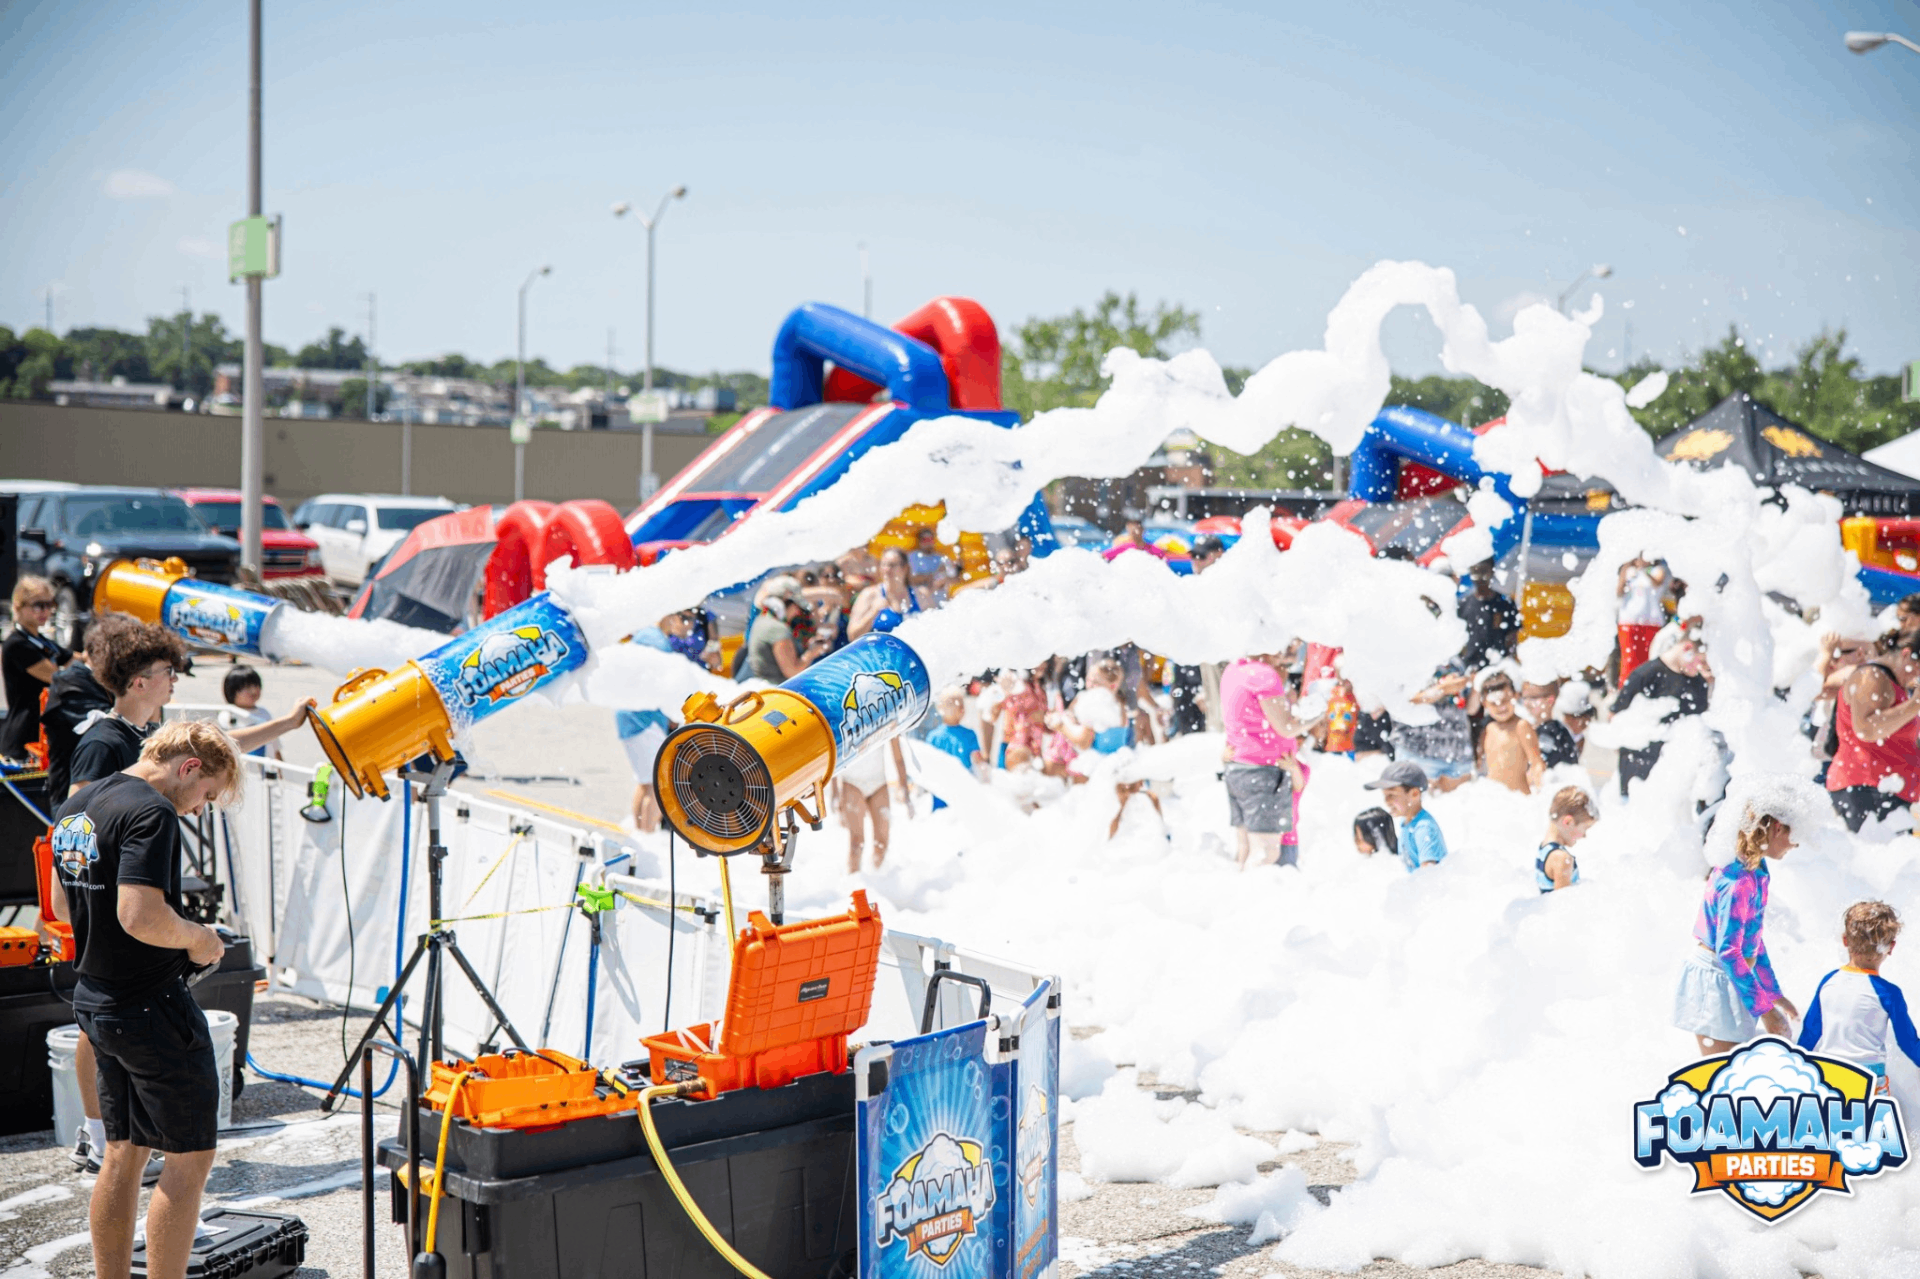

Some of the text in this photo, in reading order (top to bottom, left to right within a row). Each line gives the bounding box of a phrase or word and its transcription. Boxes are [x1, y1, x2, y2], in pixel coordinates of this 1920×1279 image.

[456, 631, 568, 704] FOAMAHA
[841, 682, 916, 757] FOAMAHA
[877, 1161, 996, 1241] FOAMAHA
[921, 1212, 963, 1240] PARTIES
